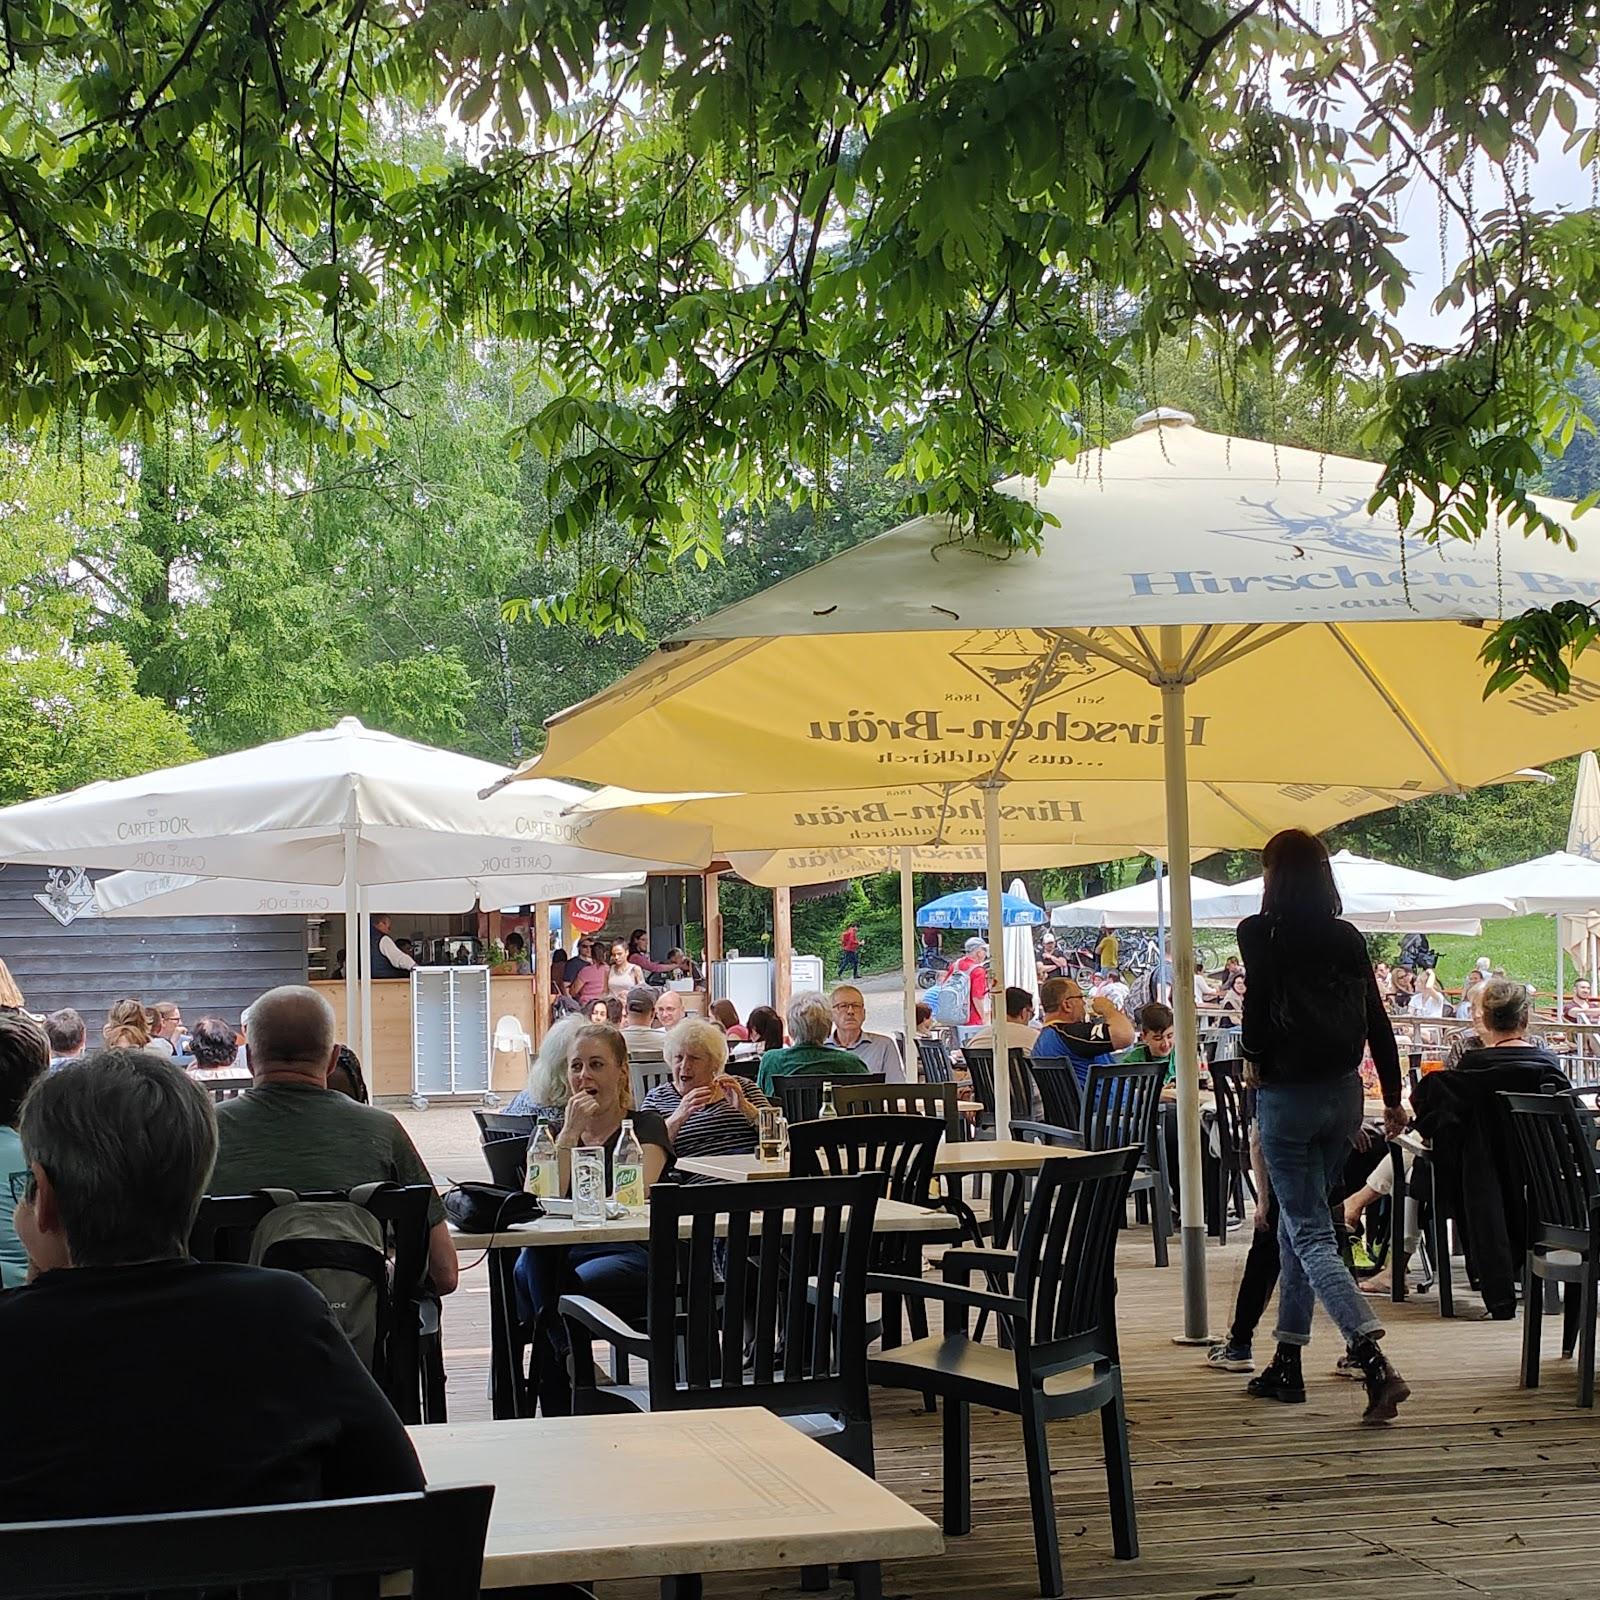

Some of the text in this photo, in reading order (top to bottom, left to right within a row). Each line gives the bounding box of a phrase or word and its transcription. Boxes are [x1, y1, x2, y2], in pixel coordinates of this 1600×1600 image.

[117, 816, 194, 840] CARTE D'OR
[515, 816, 551, 834] CARTE
